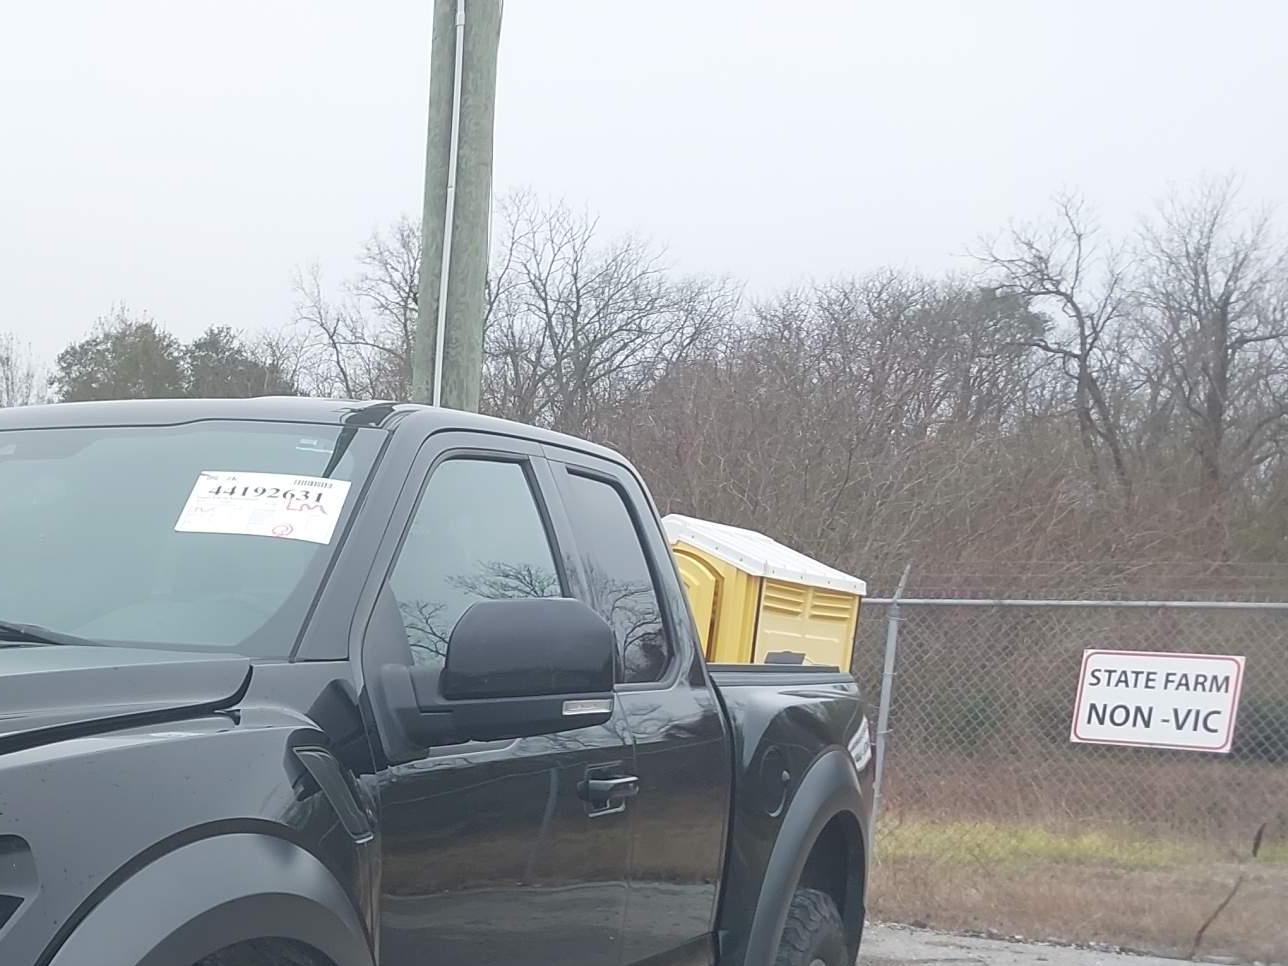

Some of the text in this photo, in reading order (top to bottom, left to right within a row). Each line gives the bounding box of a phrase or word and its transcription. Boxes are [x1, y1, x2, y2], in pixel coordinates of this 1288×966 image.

[209, 485, 322, 503] 44192631
[1089, 669, 1230, 694] STATE FARM
[1086, 703, 1222, 733] NON -VIC
